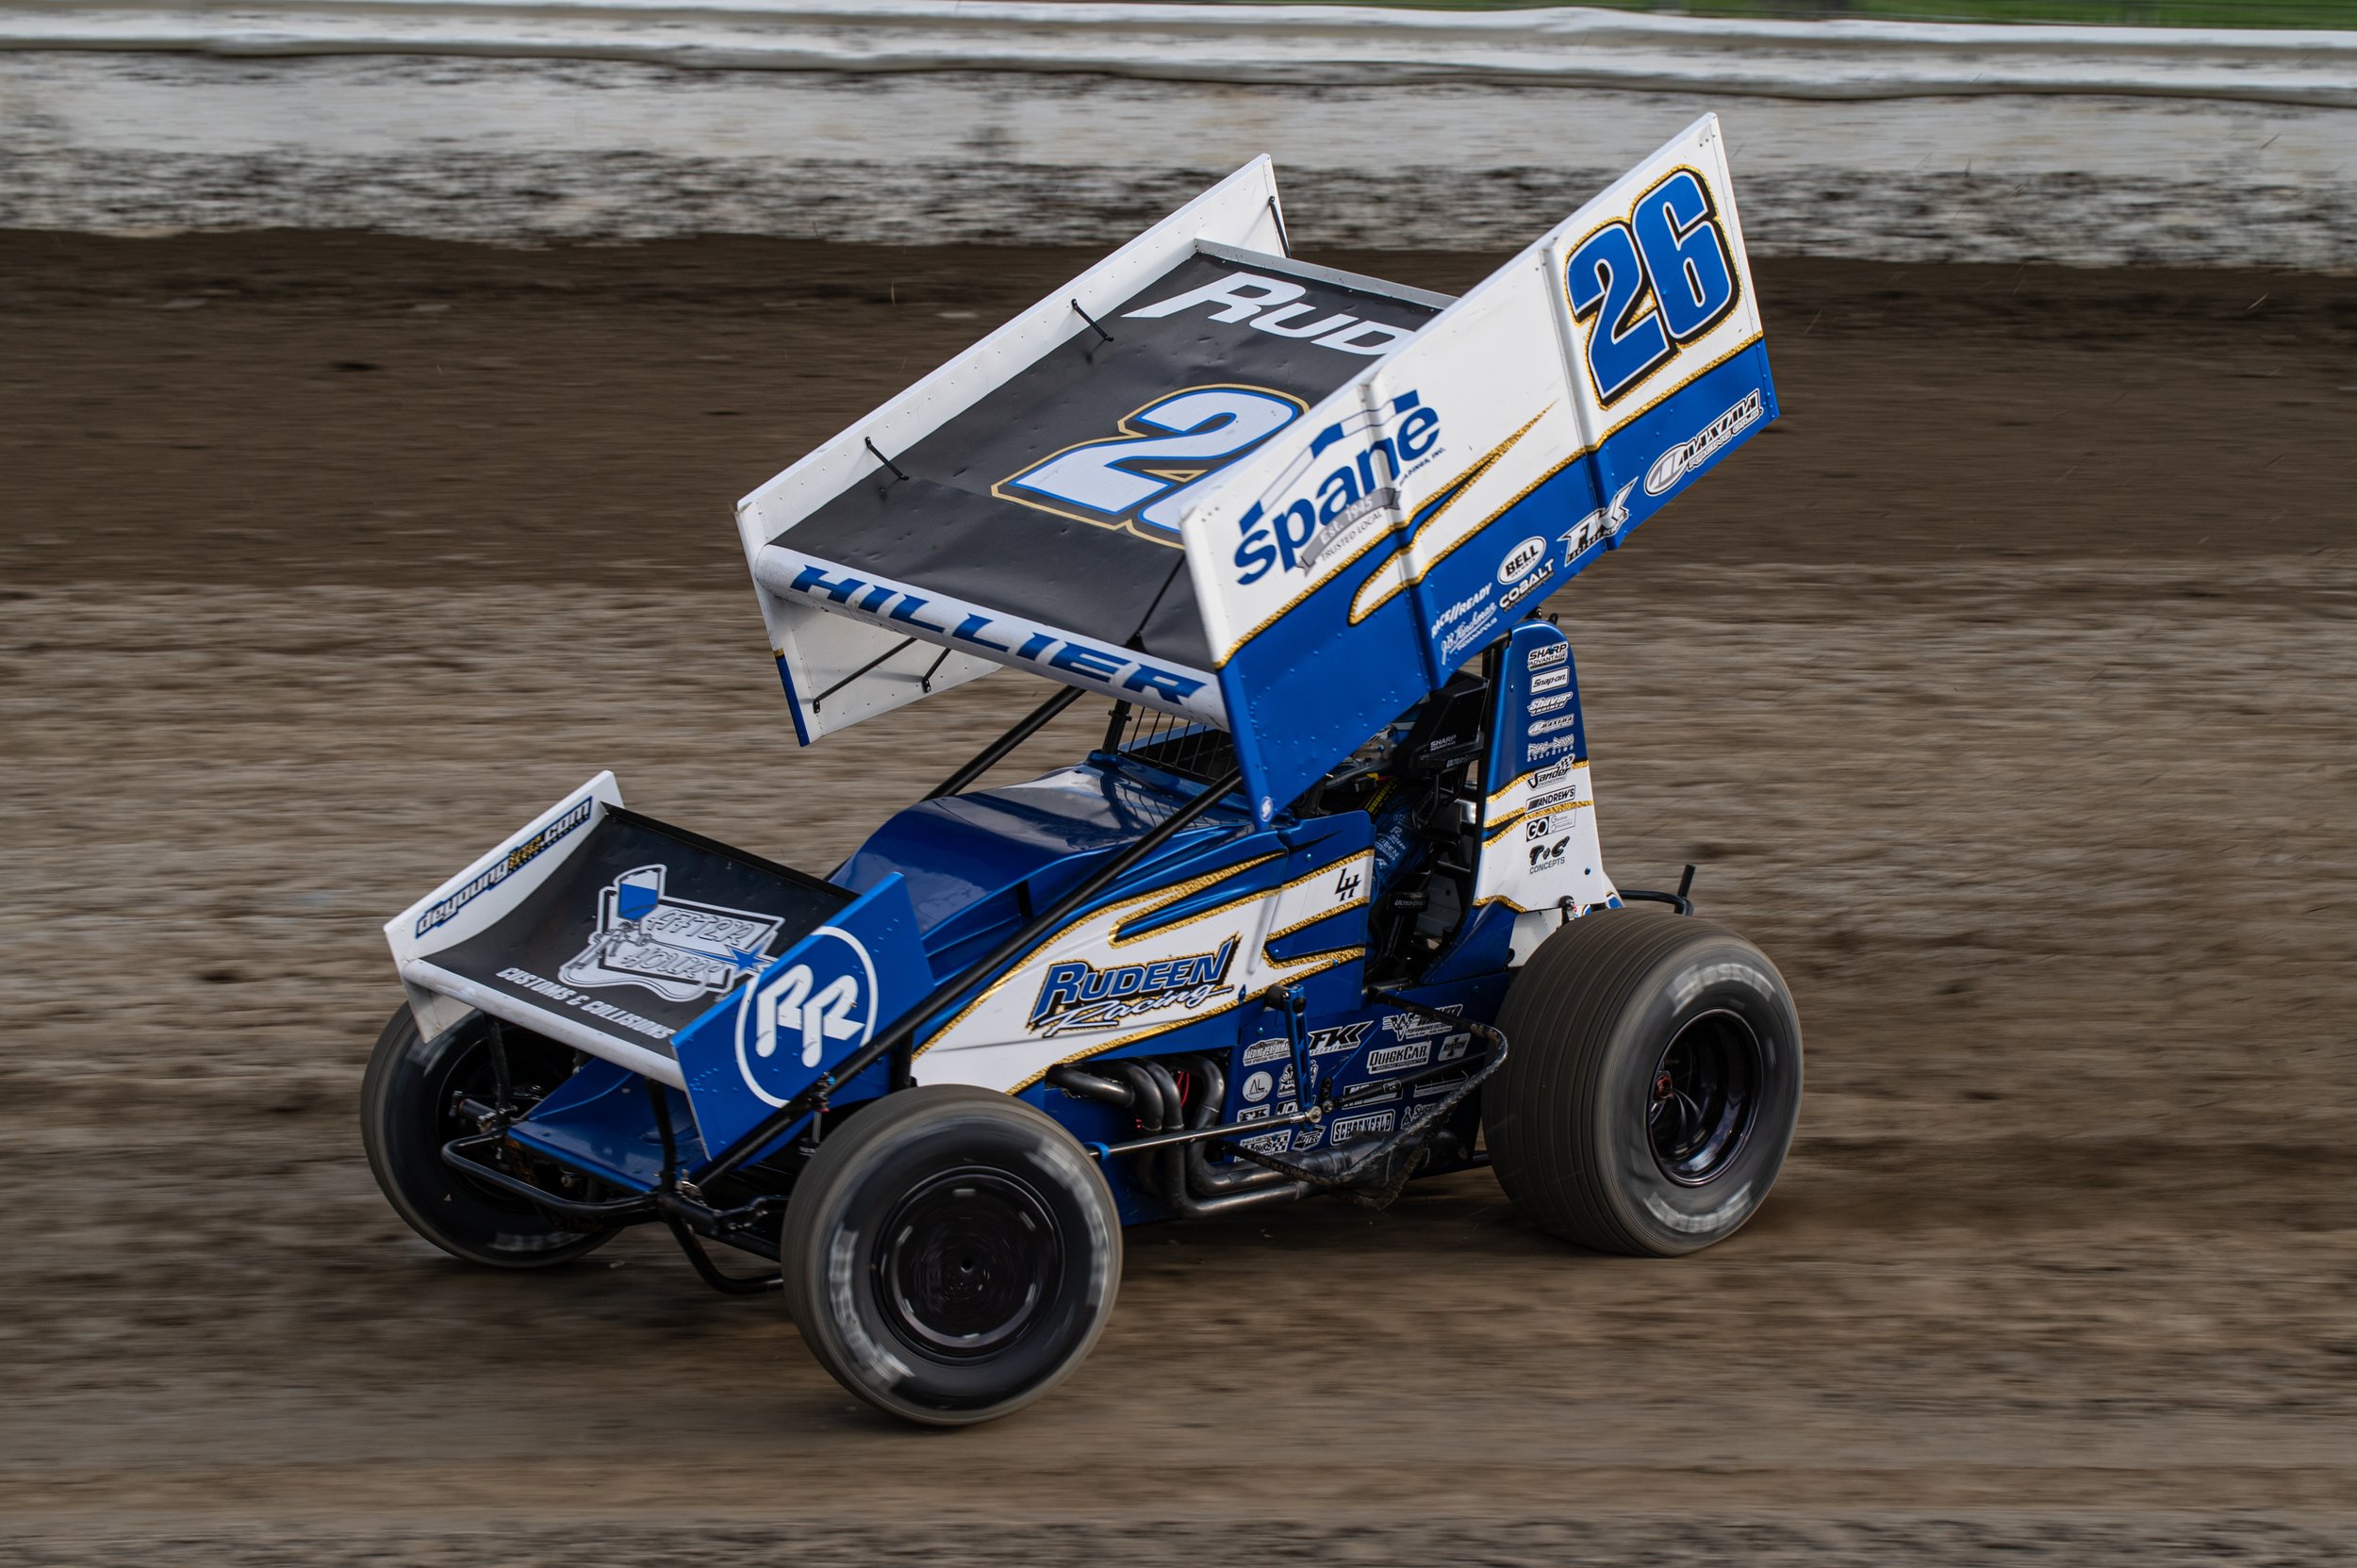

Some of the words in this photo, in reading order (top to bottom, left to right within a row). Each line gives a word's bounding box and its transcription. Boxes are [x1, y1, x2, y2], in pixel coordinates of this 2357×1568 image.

[1565, 166, 1740, 410] 26
[1234, 406, 1440, 586] spane
[1499, 558, 1554, 608] COBALT
[1506, 545, 1539, 577] BELL
[790, 564, 1207, 705] HILLIER
[1529, 643, 1567, 660] SHARP
[1527, 817, 1549, 840] GO
[1529, 856, 1565, 875] CONCEPTS
[647, 910, 754, 946] AFTER
[496, 966, 576, 999] CUSTOMS
[581, 1000, 678, 1039] COLLISIONS
[1031, 935, 1239, 1028] RUDEEN
[1038, 983, 1233, 1038] Racing
[1310, 1021, 1373, 1049] FK
